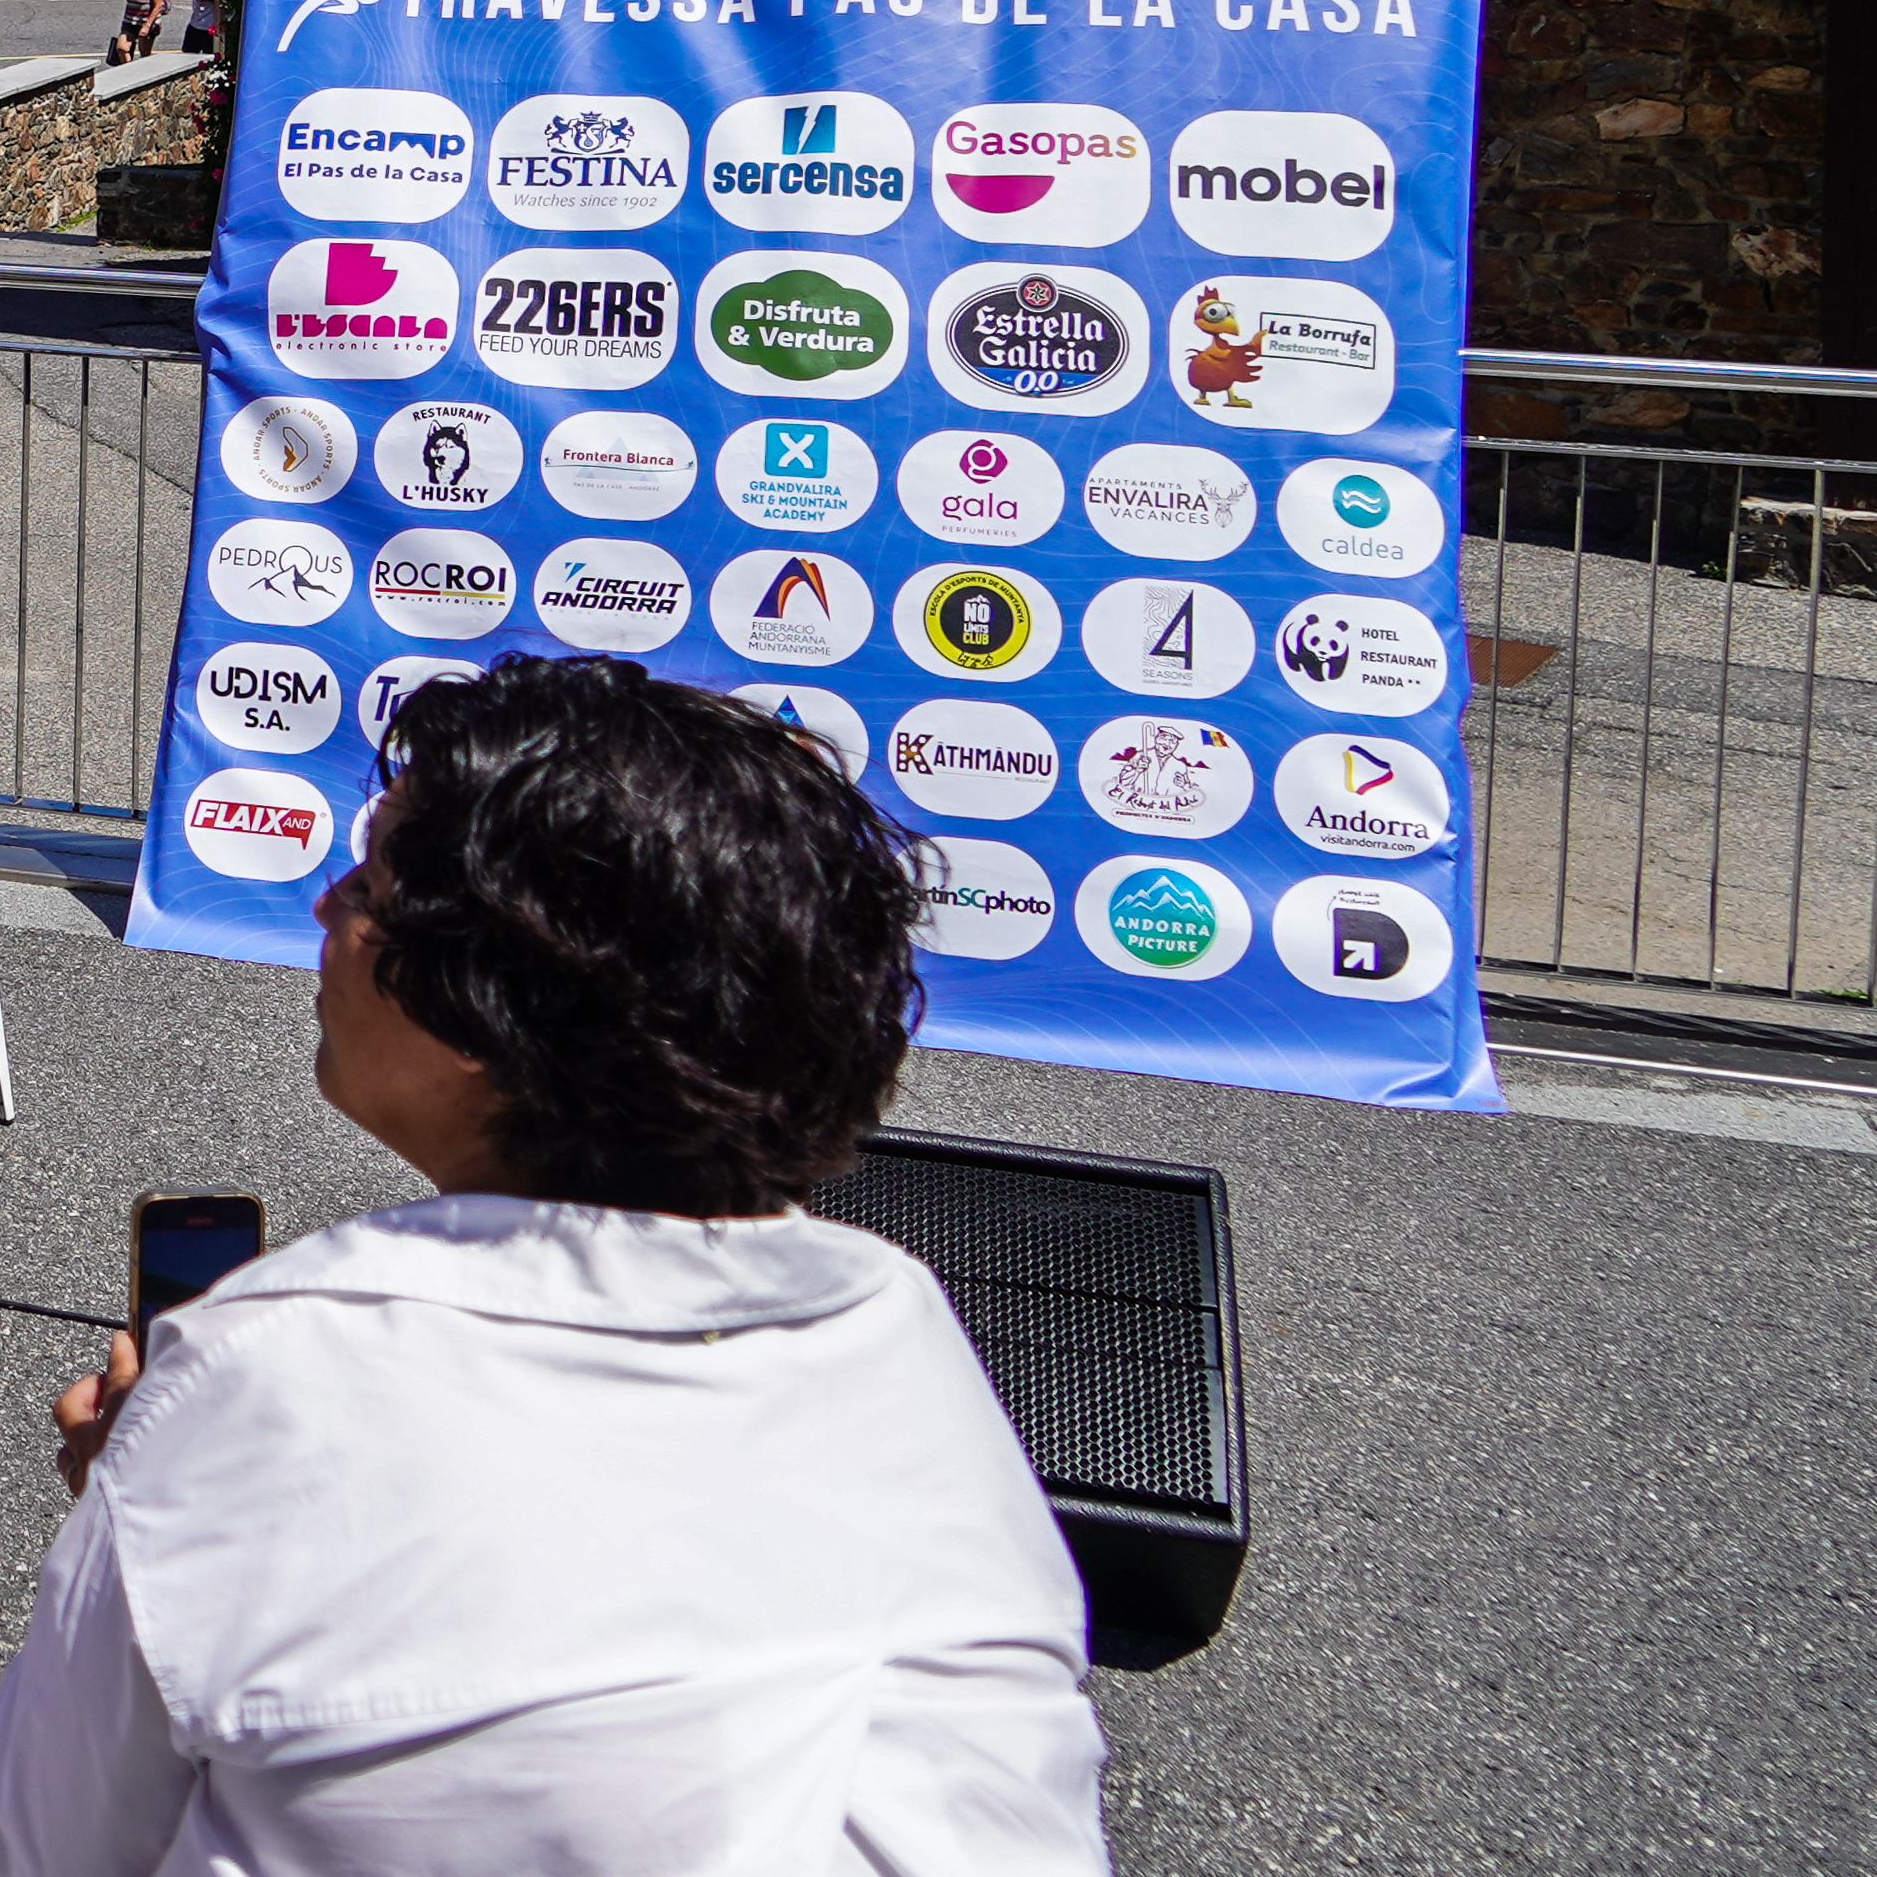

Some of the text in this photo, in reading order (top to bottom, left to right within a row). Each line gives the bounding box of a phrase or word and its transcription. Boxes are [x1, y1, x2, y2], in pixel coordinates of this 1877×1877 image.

[287, 122, 466, 159] Encamp
[946, 121, 1137, 165] Gasopas
[284, 162, 464, 184] El Pas de la Casa
[496, 156, 678, 188] FESTINA
[713, 160, 904, 202] sercensa
[1178, 158, 1385, 210] mobel
[513, 193, 657, 210] Watches since 1902
[482, 277, 666, 339] 226ERS
[744, 299, 861, 327] Disfruta
[973, 306, 1105, 343] Estrella
[1268, 320, 1372, 347] La Borrufa
[275, 341, 448, 353] electronic store
[478, 334, 662, 359] FEED YOUR DREAMS
[727, 326, 875, 353] & Verdura
[979, 336, 1097, 372] Galicia
[1269, 340, 1371, 362] Restaurant Bar
[412, 406, 492, 425] RESTAURANT
[563, 448, 675, 466] Frontera Blanca
[402, 484, 490, 504] L'HUSKY
[749, 480, 842, 497] GRANDVALIRA
[1089, 476, 1183, 490] APARTAMENTS
[742, 494, 765, 505] SKI
[778, 496, 848, 510] MOUNTAIN
[942, 492, 1018, 522] gala
[1088, 486, 1209, 512] ENVALIRA
[763, 508, 826, 522] ACADEMY
[1110, 506, 1210, 525] VACANCES
[942, 525, 1018, 538] PERFUMERIES
[1321, 535, 1404, 561] caldea
[219, 545, 343, 574] PEDROUS
[375, 560, 507, 593] ROCROI
[576, 576, 685, 598] CIRCUIT
[375, 595, 507, 607] www.rocroi.com
[541, 591, 678, 615] ANDORRA
[964, 602, 990, 623] NO
[749, 631, 827, 646] ANDORRANA
[751, 621, 815, 635] FEDERACIÓ
[962, 633, 989, 645] CLUB
[1361, 628, 1400, 641] HOTEL
[748, 641, 832, 657] MUNTANYISME
[1360, 651, 1438, 669] RESTAURANT
[210, 666, 327, 705] UDISM
[1142, 669, 1194, 681] SEASONS
[1362, 673, 1405, 687] PANDA
[244, 707, 291, 731] S.A.
[193, 803, 285, 836] FLAIX
[1305, 805, 1431, 840] Andorra
[1320, 833, 1416, 853] visitandorra.com
[1114, 915, 1211, 937] ANDORRA
[1127, 934, 1198, 953] PICTURE
